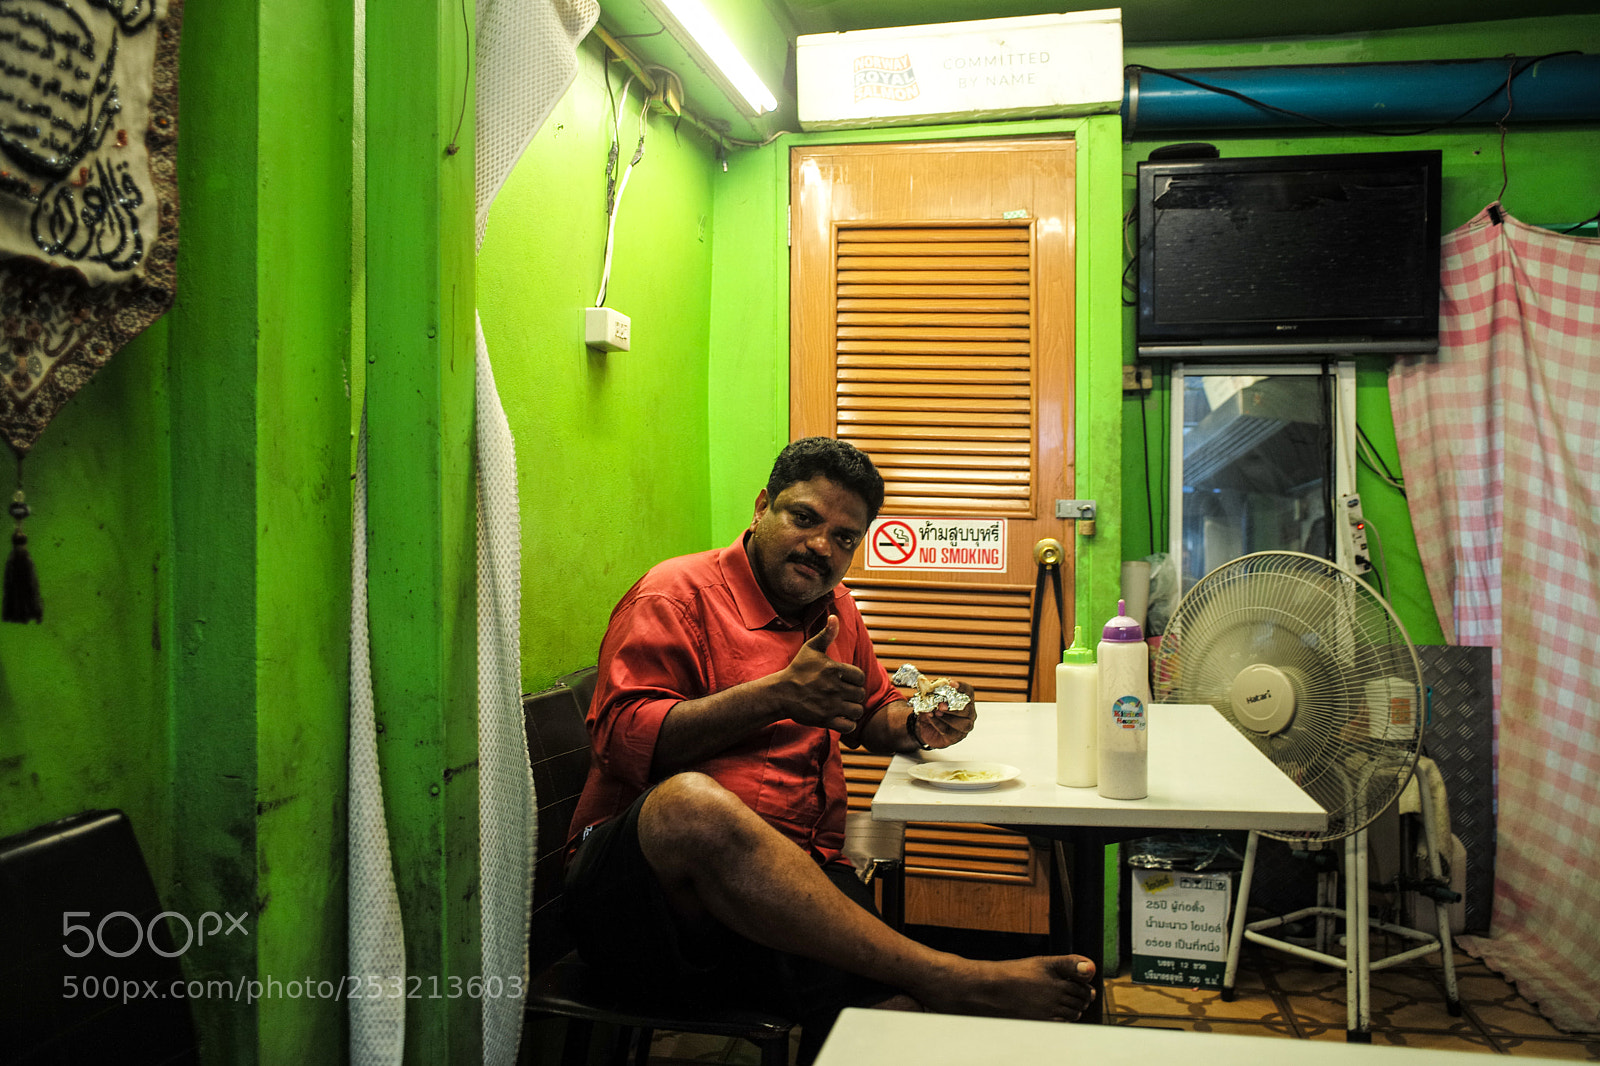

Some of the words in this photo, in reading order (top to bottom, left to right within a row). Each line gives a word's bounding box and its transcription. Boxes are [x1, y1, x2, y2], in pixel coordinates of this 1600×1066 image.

[854, 55, 909, 72] NORWAY
[943, 51, 1051, 70] COMMITTED
[854, 70, 916, 87] ROYAL
[958, 76, 978, 89] BY
[986, 72, 1037, 87] NAME
[854, 82, 920, 101] SALMON
[918, 521, 1000, 547] ห้ามสูบบุหรี่
[919, 547, 937, 563] NO
[941, 548, 999, 565] SMOKING
